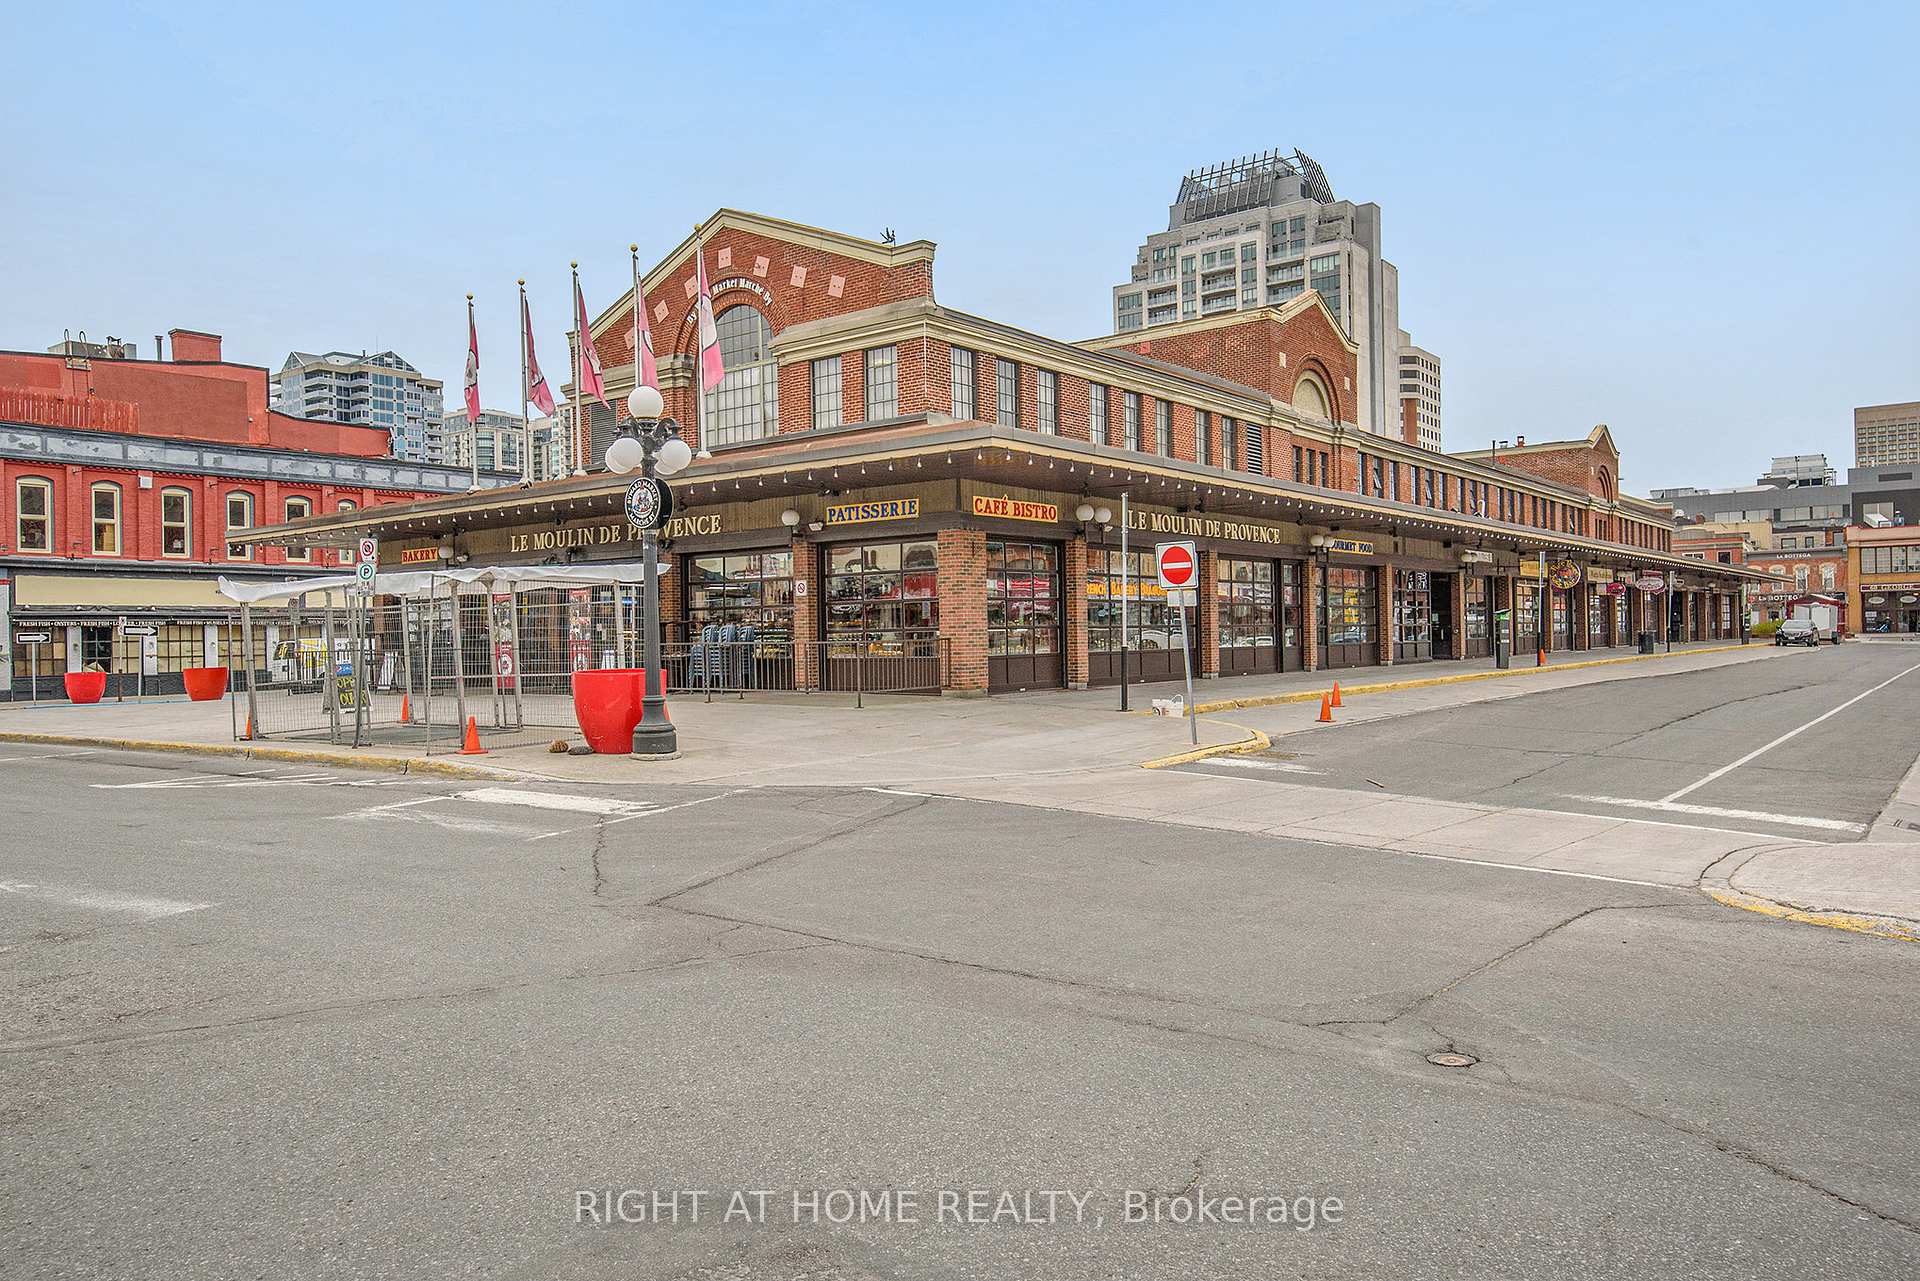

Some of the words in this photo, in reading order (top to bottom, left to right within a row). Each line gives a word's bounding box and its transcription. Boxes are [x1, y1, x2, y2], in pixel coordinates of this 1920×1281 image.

[712, 279, 738, 295] Market
[827, 499, 918, 524] PATISSERIE
[974, 493, 1009, 516] CAFÉ
[1013, 501, 1057, 521] BISTRO
[511, 535, 529, 553] LE
[534, 527, 595, 551] MOULIN
[599, 525, 621, 545] DE
[627, 514, 722, 541] PVENCE
[1128, 509, 1147, 530] LE
[1151, 513, 1202, 537] MOULIN
[1205, 519, 1222, 539] DE
[1223, 522, 1281, 545] PROVENCE
[402, 548, 437, 563] BAKERY
[363, 568, 370, 577] P
[1110, 582, 1137, 596] BAERY
